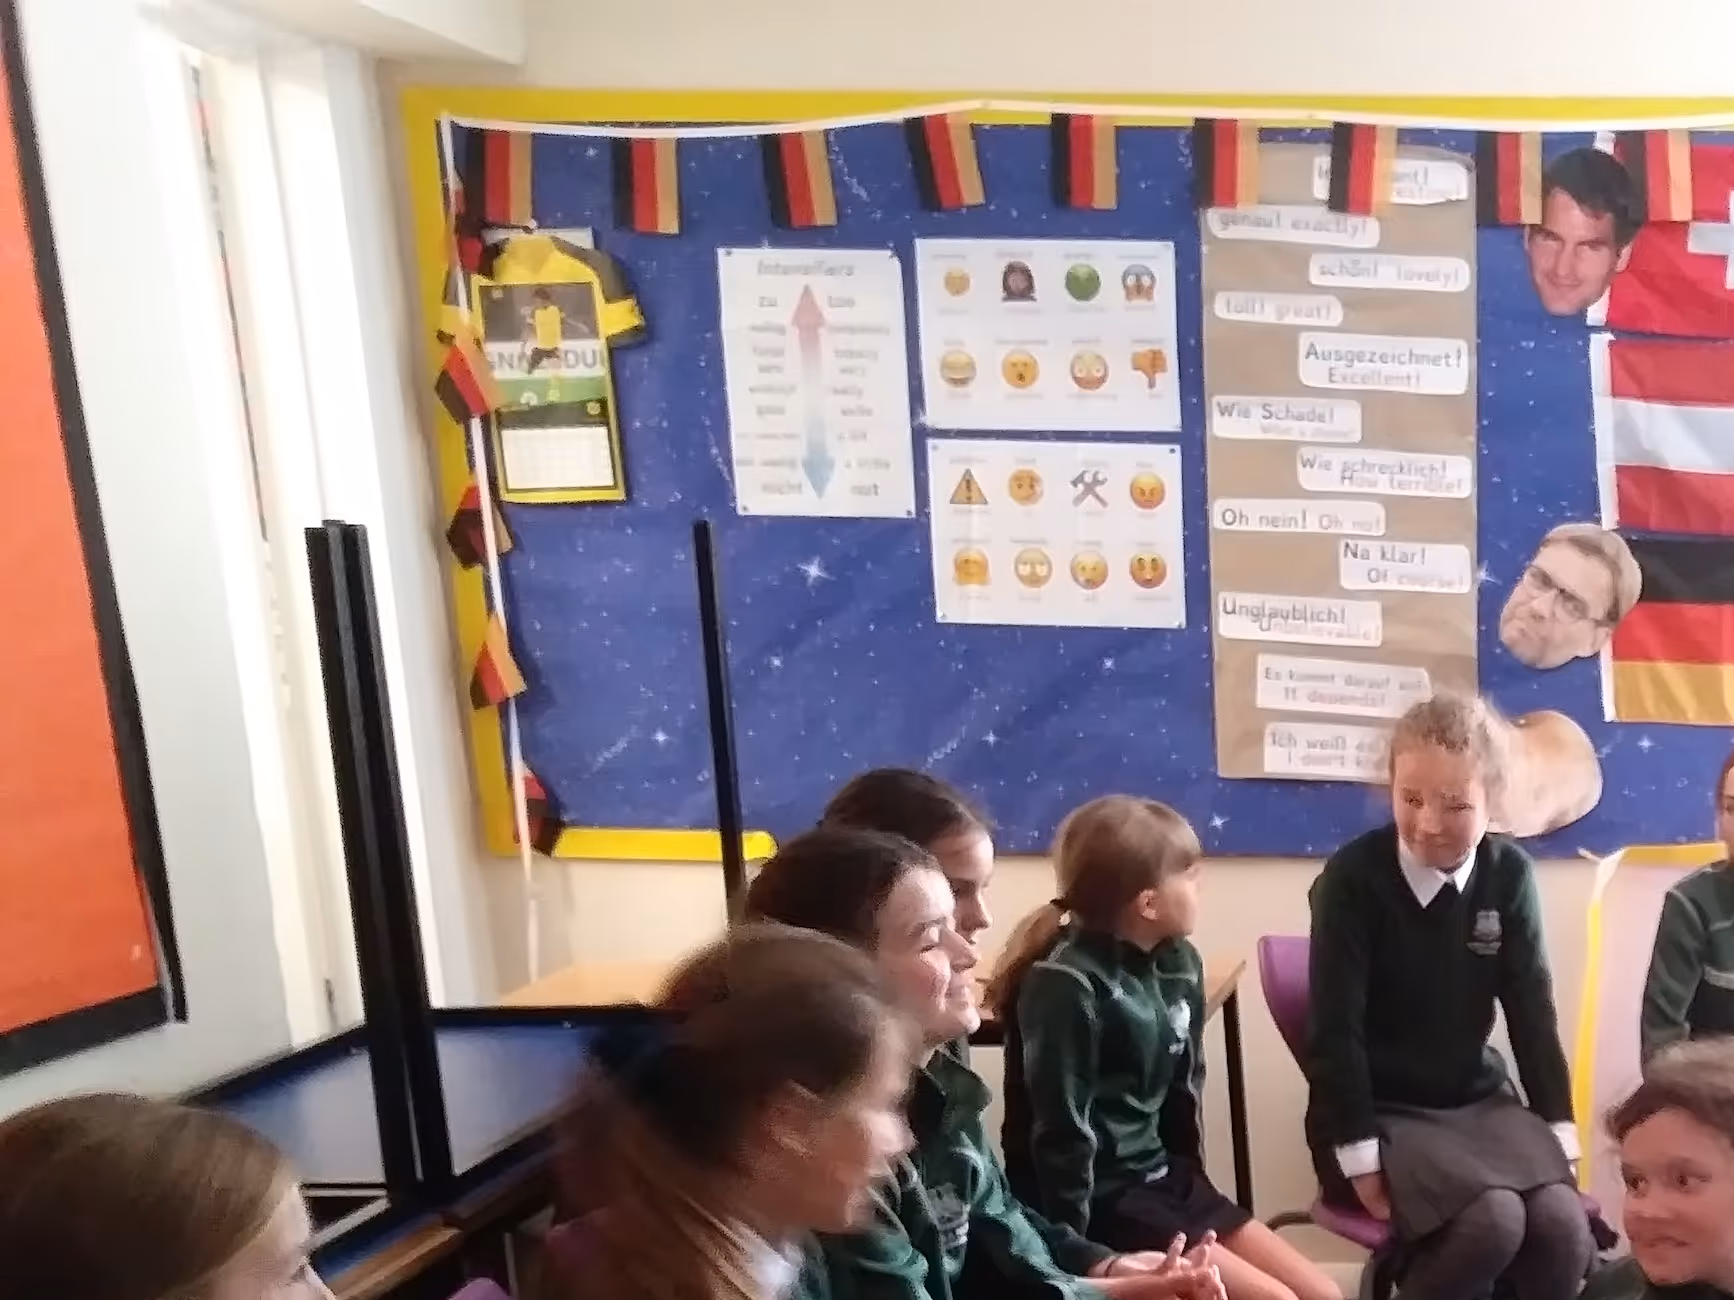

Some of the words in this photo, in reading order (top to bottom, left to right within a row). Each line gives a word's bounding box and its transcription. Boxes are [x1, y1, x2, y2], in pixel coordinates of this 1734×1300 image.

[1318, 258, 1378, 279] schön!
[1304, 341, 1462, 368] Ausgezeichnet!
[1327, 366, 1421, 387] Excellent!
[1217, 401, 1251, 419] Wie
[1261, 403, 1335, 424] Schade!
[1300, 455, 1332, 472] Wie
[1341, 459, 1447, 479] schrecklich!
[1221, 508, 1249, 527] Oh
[1258, 509, 1308, 529] nein!
[1319, 513, 1343, 530] Oh
[1343, 541, 1370, 561] Na
[1379, 543, 1426, 564] klar!
[1222, 597, 1346, 625] Unglaublich!
[1270, 731, 1297, 748] Ich
